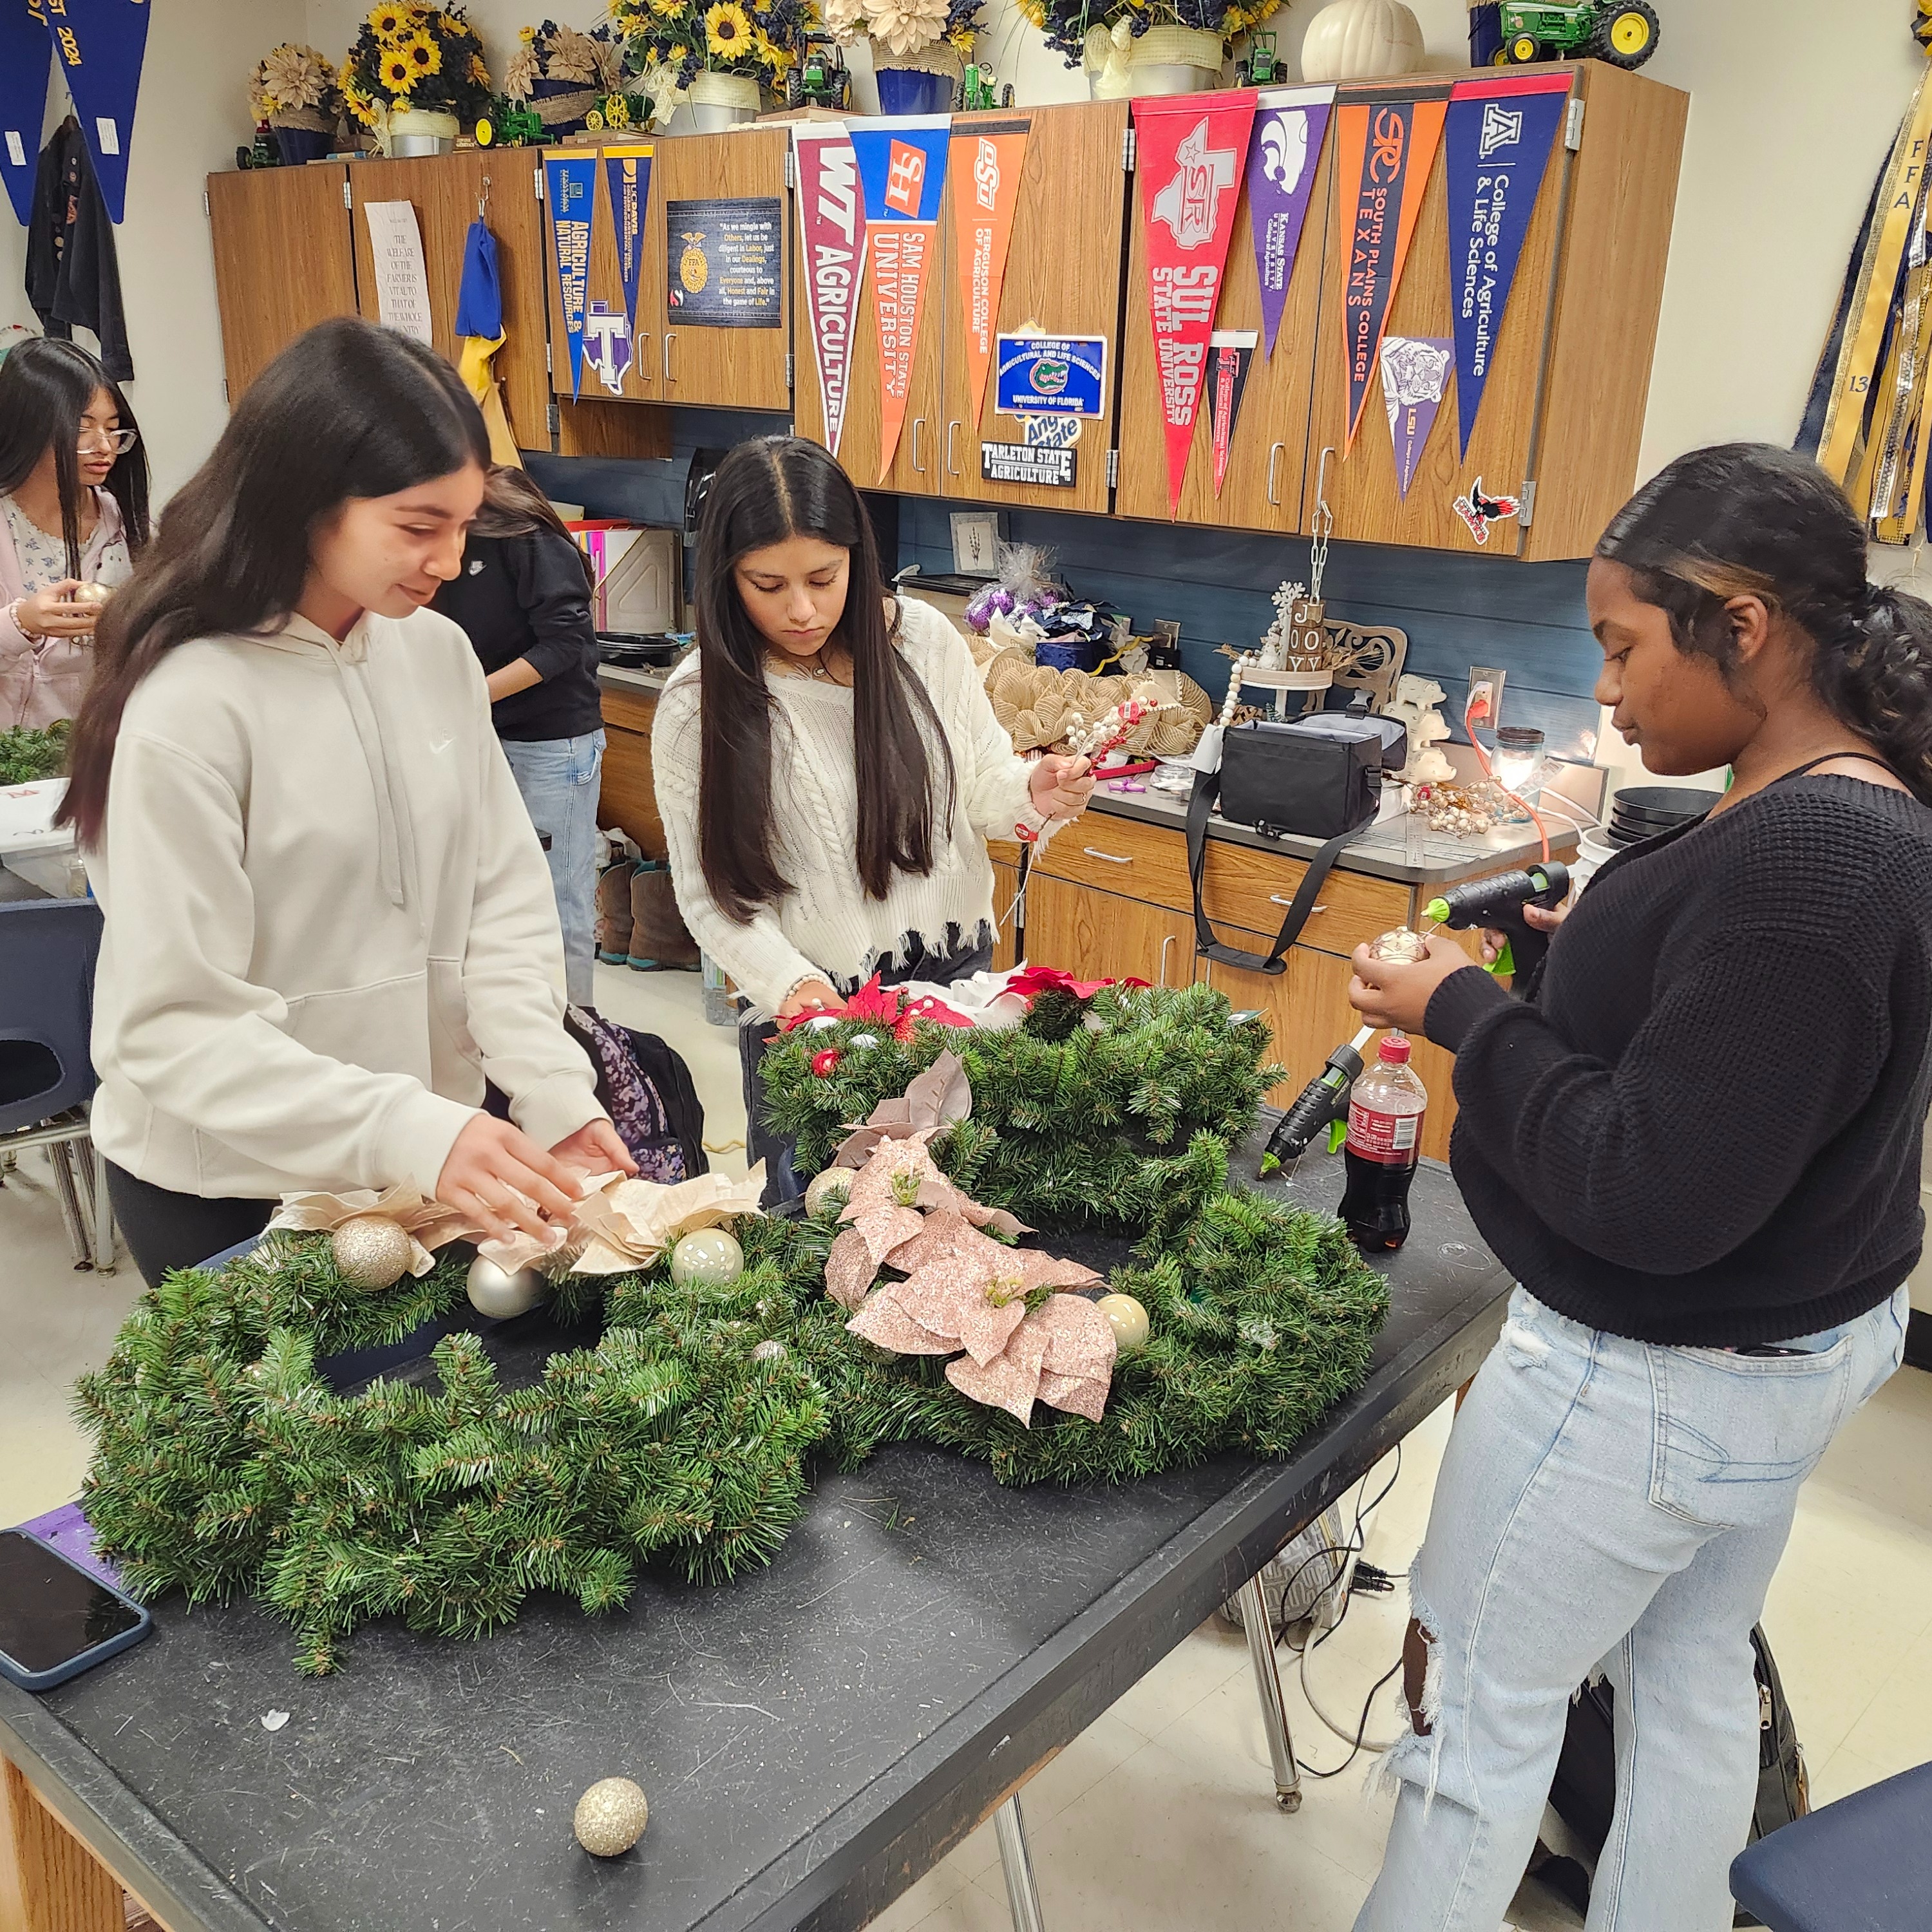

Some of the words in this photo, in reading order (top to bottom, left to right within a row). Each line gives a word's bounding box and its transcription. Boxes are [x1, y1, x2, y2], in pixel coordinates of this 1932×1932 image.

[56, 26, 83, 66] 2024
[887, 151, 922, 206] SH
[974, 137, 999, 211] OSU
[1476, 176, 1492, 195] &
[819, 146, 857, 247] WT
[1370, 187, 1387, 245] SOUTH
[1472, 198, 1490, 232] Life
[1484, 174, 1510, 247] College
[556, 220, 571, 269] NATURAL
[724, 234, 743, 242] Others,
[761, 233, 768, 242] be
[739, 222, 758, 231] mingle
[759, 222, 772, 231] with
[975, 228, 984, 245] OF
[1277, 212, 1289, 256] KANSAS
[1348, 188, 1376, 307] TEXANS
[386, 247, 415, 257] WELFARE
[391, 260, 400, 270] OF
[399, 260, 412, 270] THE
[571, 221, 589, 314] AGRICULTURE
[718, 245, 739, 253] diligent
[746, 245, 762, 253] Labor,
[764, 244, 774, 253] just
[741, 255, 767, 264] Dealings,
[902, 232, 925, 269] SAM
[980, 228, 992, 297] FERGUSON
[1269, 213, 1279, 290] UNIVERSITY
[1484, 251, 1498, 272] of
[387, 274, 410, 283] FARMER
[389, 287, 406, 296] VITAL
[406, 287, 417, 296] TO
[719, 276, 743, 285] Everyone
[744, 276, 755, 285] and,
[757, 276, 774, 285] above
[972, 249, 983, 334] AGRICULTURE
[1276, 258, 1285, 290] STATE
[1362, 249, 1379, 307] PLAINS
[1462, 237, 1484, 319] Sciences
[391, 299, 407, 308] THAT
[399, 312, 422, 322] WHOLE
[562, 274, 574, 334] RESOURCES
[873, 232, 900, 398] UNIVERSITY
[898, 274, 920, 348] HOUSTON
[1152, 267, 1174, 333] STATE
[1172, 265, 1218, 332] SUL
[573, 320, 582, 333] &
[815, 244, 854, 433] AGRICULTURE
[979, 299, 989, 355] COLLEGE
[1031, 341, 1061, 350] COLLEGE
[1061, 342, 1070, 351] OF
[1354, 310, 1370, 382] COLLEGE
[1473, 274, 1496, 377] Agriculture
[895, 352, 910, 399] STATE
[999, 350, 1041, 377] AGRICULTURAL
[1043, 350, 1056, 358] AND
[1057, 351, 1071, 361] LIFE
[1071, 355, 1101, 381] SCIENCES
[1158, 338, 1175, 425] UNIVERSITY
[1173, 342, 1204, 426] ROSS
[1848, 375, 1869, 393] 13
[1012, 394, 1047, 405] UNIVERSITY
[1047, 397, 1056, 406] OF
[1057, 397, 1084, 406] FLORIDA
[1406, 408, 1417, 435] LSU
[982, 443, 1035, 469] TARLETON
[1037, 448, 1072, 477] STATE
[990, 464, 1059, 485] AGRICULTURE
